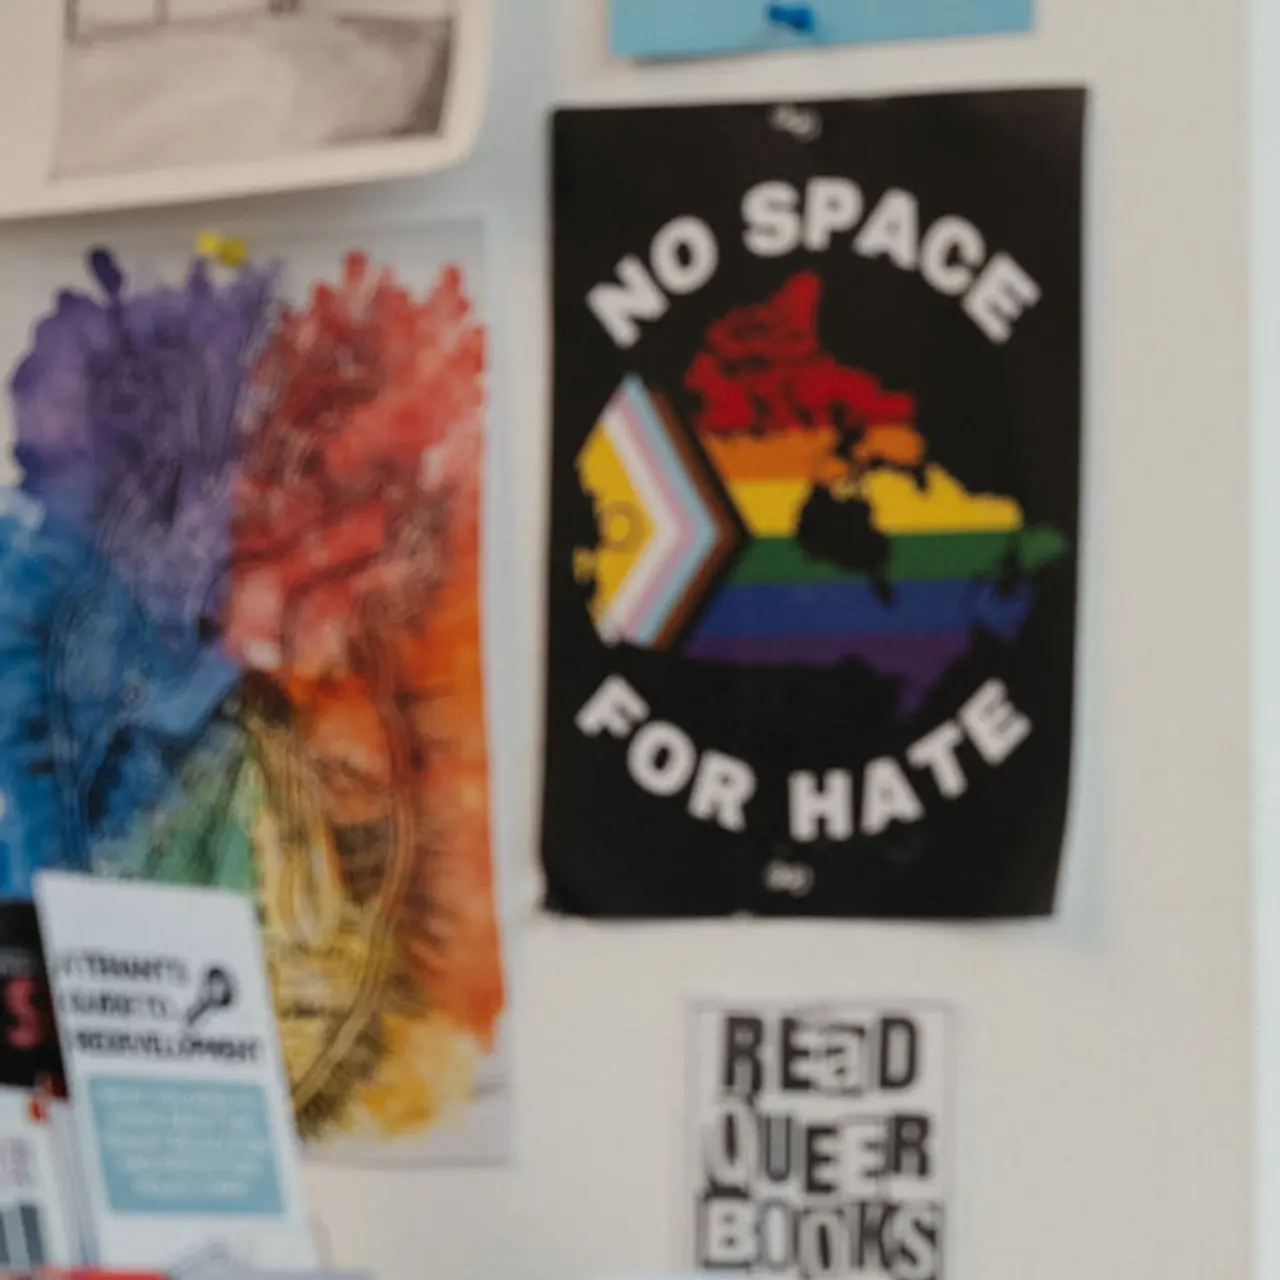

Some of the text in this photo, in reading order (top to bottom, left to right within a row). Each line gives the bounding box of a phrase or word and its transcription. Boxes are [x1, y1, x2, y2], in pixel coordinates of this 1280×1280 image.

[586, 178, 1040, 347] NO SPACE
[575, 676, 1031, 840] FOR HATE
[703, 1100, 932, 1196] QUEER
